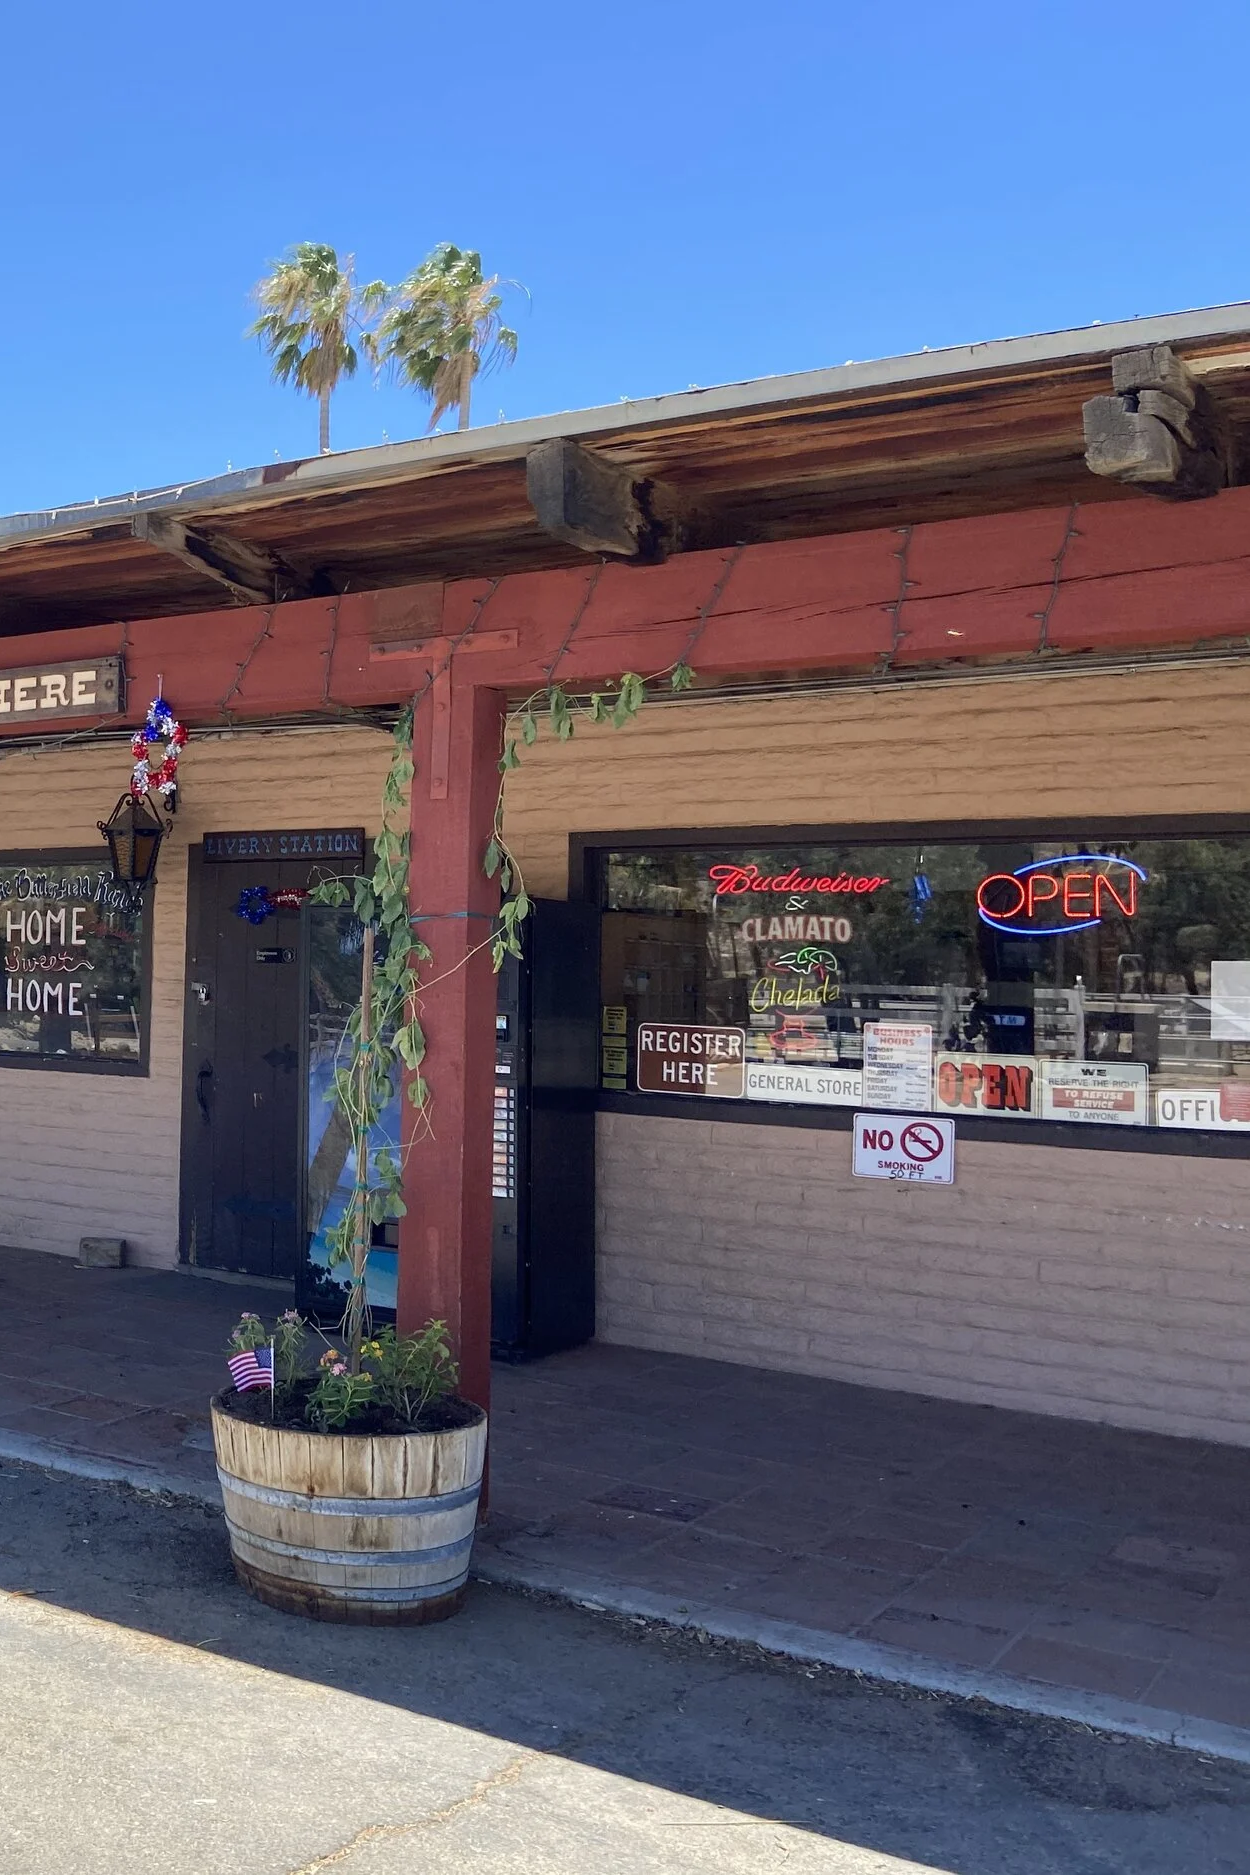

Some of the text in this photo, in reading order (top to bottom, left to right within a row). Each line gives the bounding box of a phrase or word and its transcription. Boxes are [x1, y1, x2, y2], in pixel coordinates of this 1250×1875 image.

[206, 834, 359, 855] LIVERY STATION
[15, 867, 93, 902] Butterfield
[708, 864, 891, 895] Budweiser
[784, 895, 810, 911] &
[977, 871, 1138, 919] OPEN
[6, 907, 87, 946] HOME
[741, 915, 853, 943] CLAMATO
[4, 946, 95, 973] Sweet
[6, 978, 84, 1016] HOME
[751, 975, 842, 1013] Chelada
[641, 1029, 742, 1057] REGISTER
[873, 1028, 923, 1038] BUSINESS
[880, 1037, 915, 1046] HOURS
[662, 1060, 719, 1086] HERE
[867, 1061, 903, 1069] WEDNESDAY
[1081, 1068, 1107, 1077] WE
[749, 1073, 862, 1097] GENERAL STORE
[938, 1061, 1033, 1112] OPEN
[1048, 1077, 1139, 1088] RESERVE THE RIGHT
[1064, 1089, 1124, 1101] TO REFUSE
[1073, 1099, 1115, 1109] SERVICE
[1069, 1110, 1119, 1121] TO ANYONE
[1161, 1098, 1216, 1122] OFFI
[862, 1128, 894, 1151] NO
[877, 1160, 925, 1172] SMOKING
[890, 1169, 905, 1180] 50
